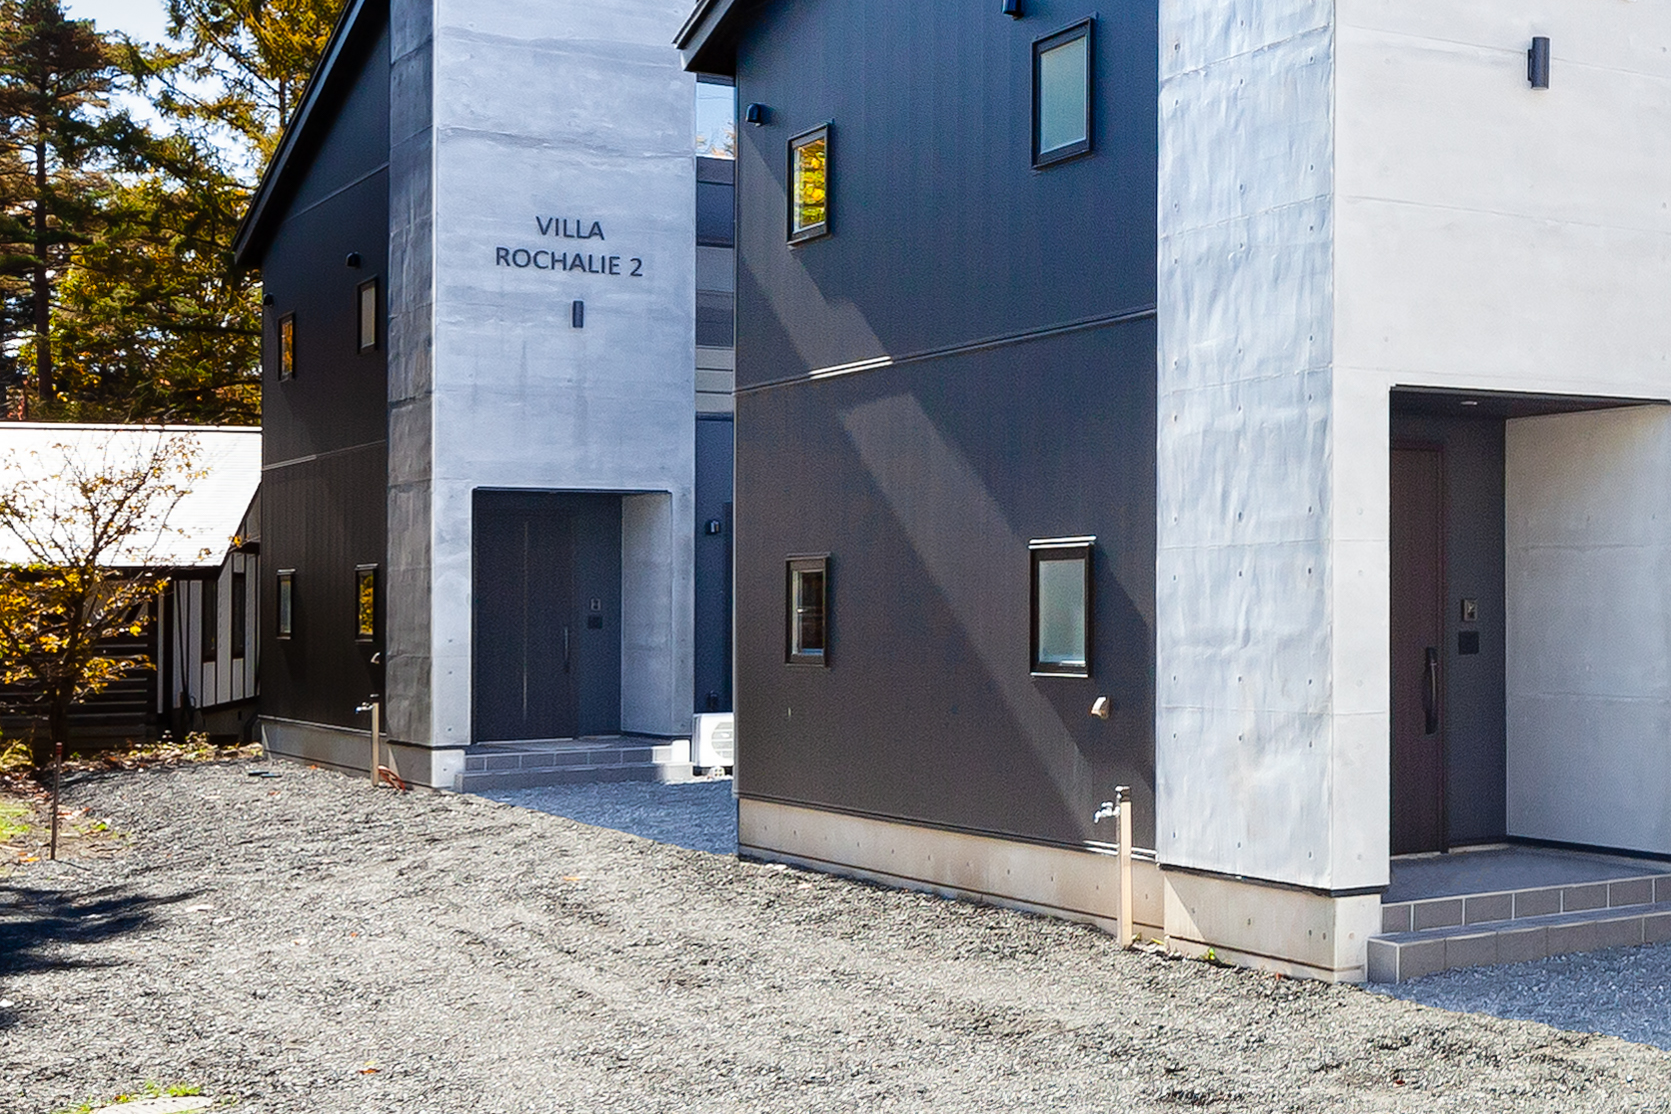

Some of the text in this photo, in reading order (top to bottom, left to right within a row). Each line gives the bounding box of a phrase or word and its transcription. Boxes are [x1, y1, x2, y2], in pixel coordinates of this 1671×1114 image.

[535, 215, 605, 241] VILLA
[495, 246, 643, 277] ROCHALIE 2
